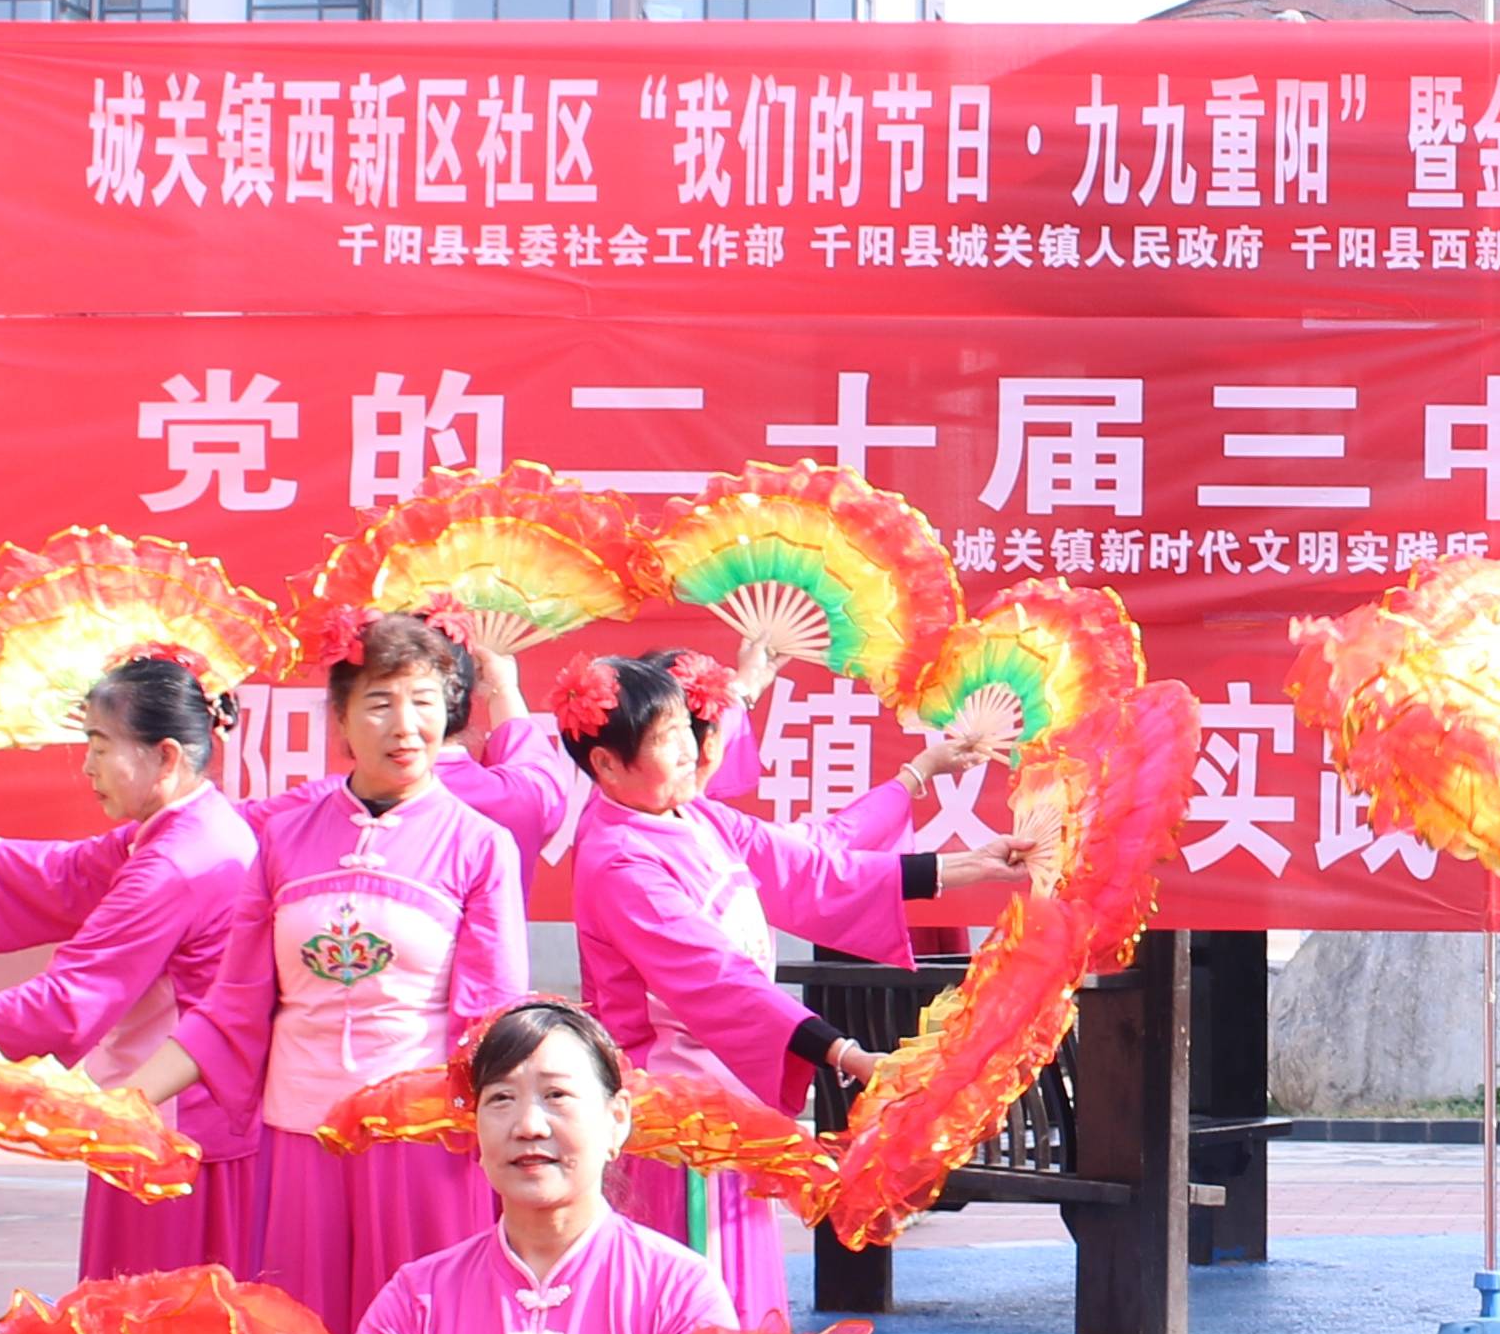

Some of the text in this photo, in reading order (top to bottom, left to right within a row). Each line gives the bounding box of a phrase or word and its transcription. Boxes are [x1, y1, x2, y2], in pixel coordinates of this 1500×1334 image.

[338, 222, 786, 269] 千阳县县委社会工作部
[810, 223, 1265, 271] 千阳县城关镇人民政府
